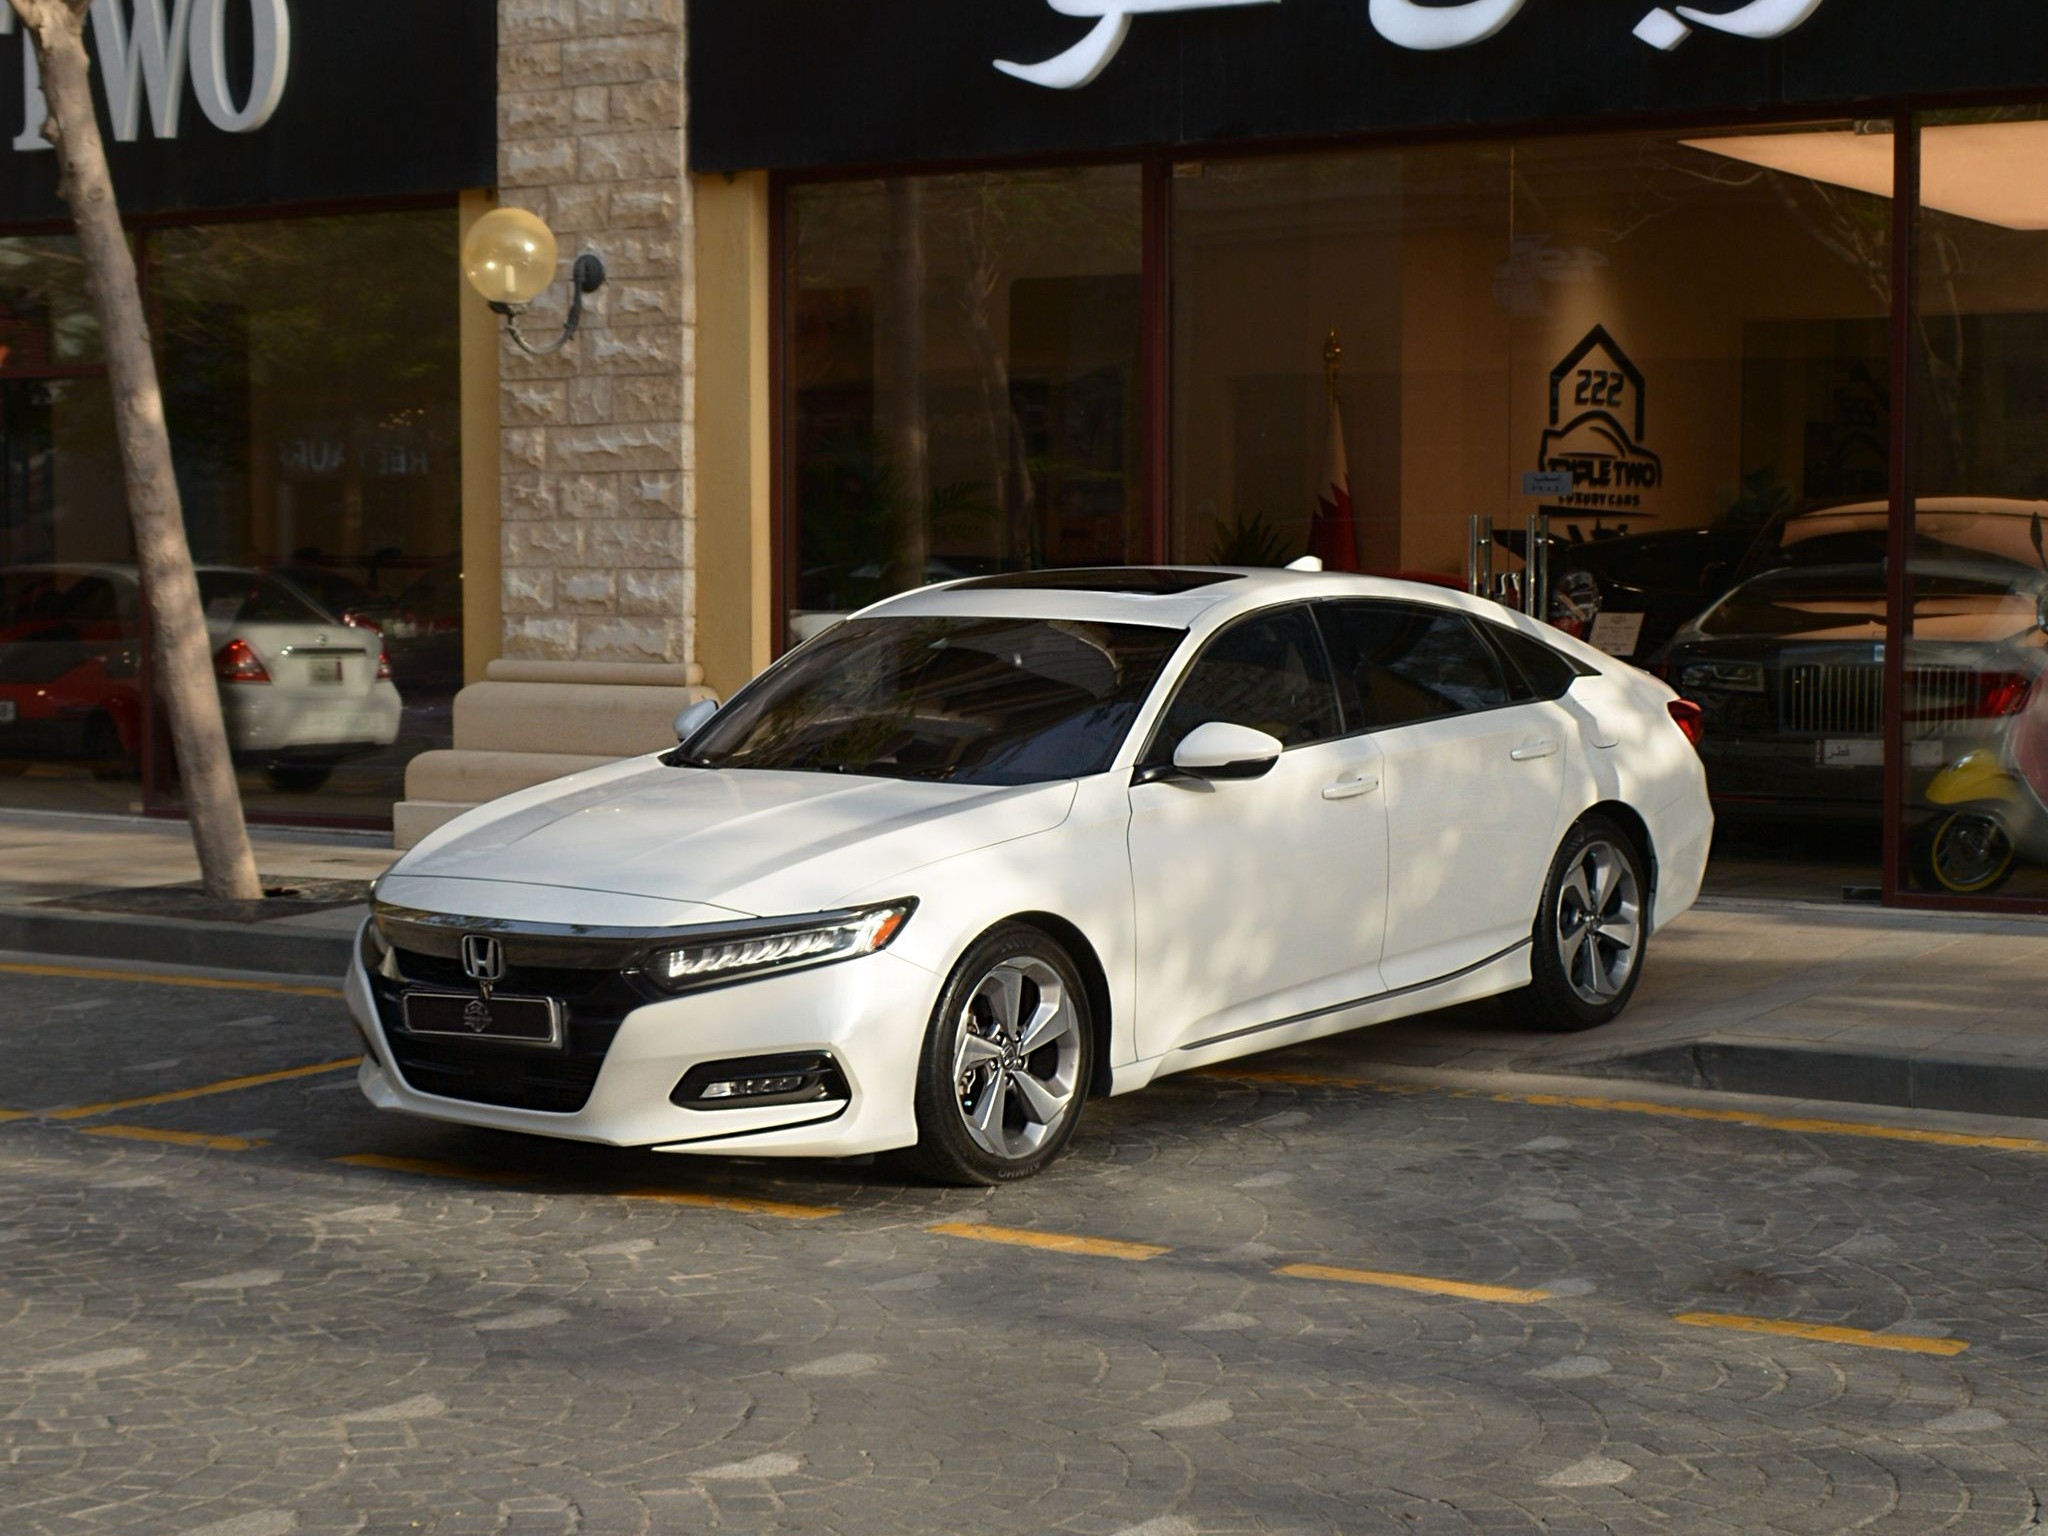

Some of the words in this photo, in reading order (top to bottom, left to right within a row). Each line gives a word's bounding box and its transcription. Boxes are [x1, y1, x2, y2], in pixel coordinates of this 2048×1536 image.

[1574, 370, 1624, 407] 222
[1614, 461, 1657, 488] TWO
[1608, 493, 1641, 507] CARS
